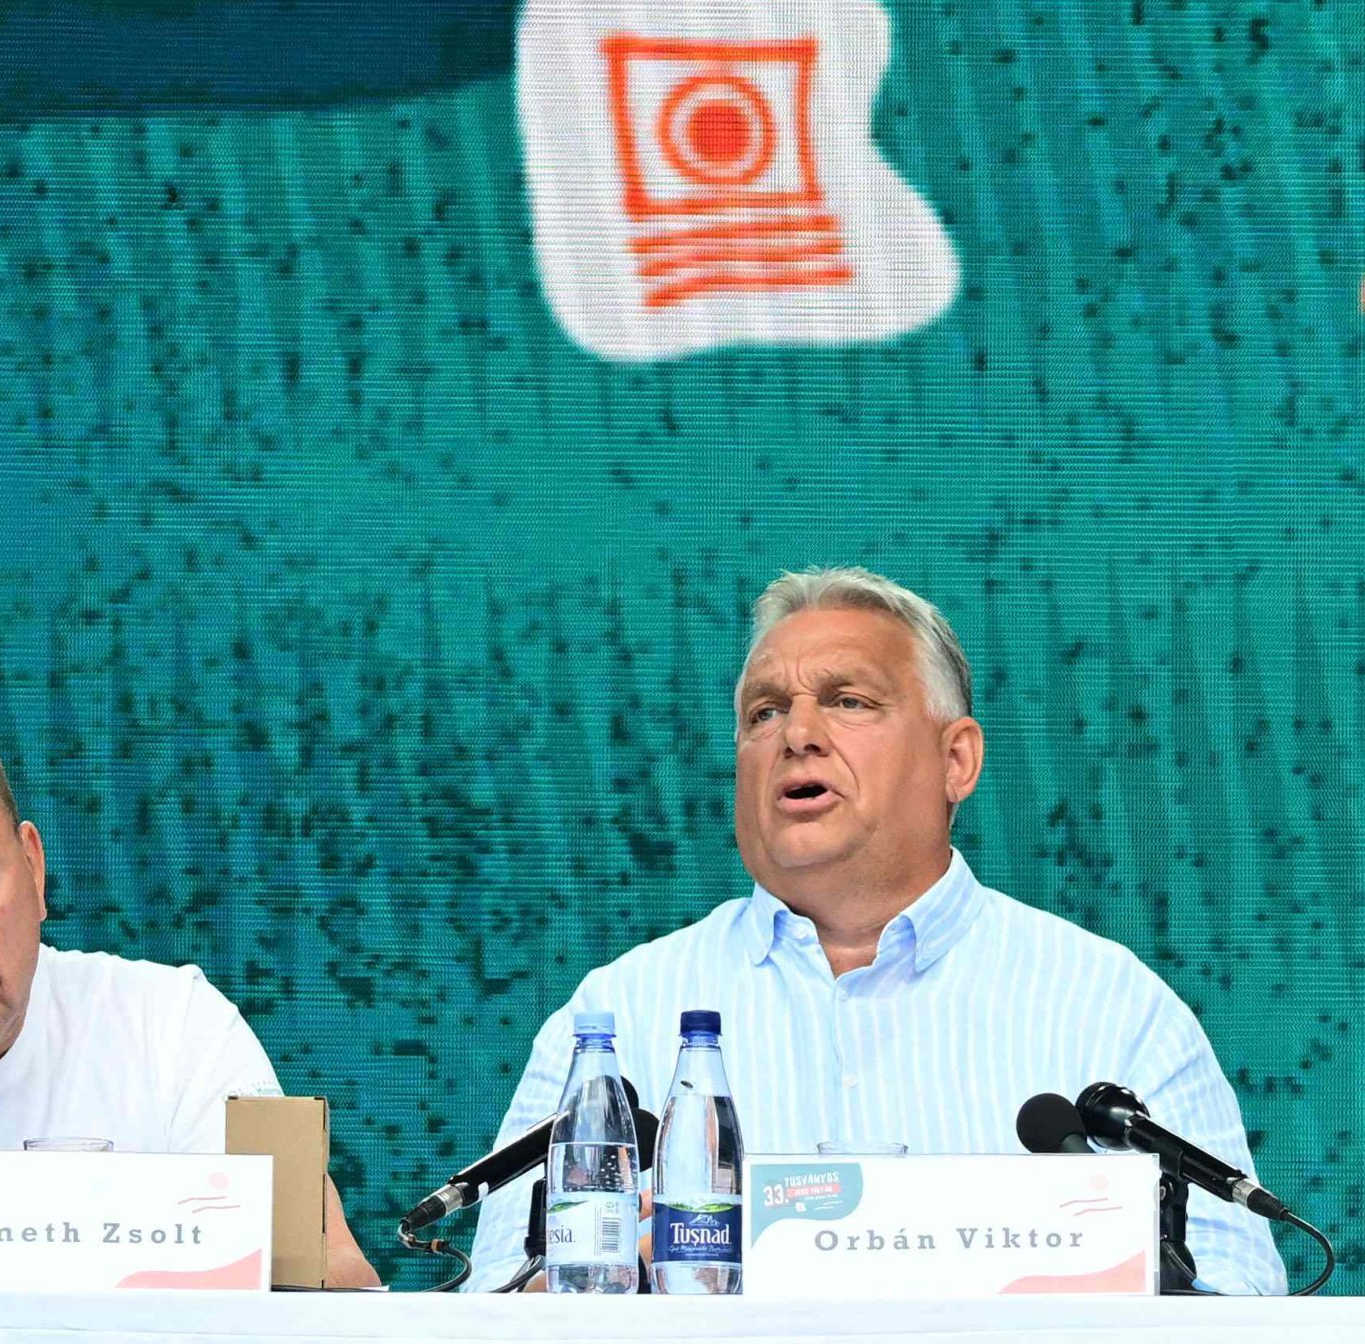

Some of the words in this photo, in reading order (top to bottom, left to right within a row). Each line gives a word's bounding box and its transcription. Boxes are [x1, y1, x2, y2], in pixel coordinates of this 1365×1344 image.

[763, 1183, 789, 1207] 33.
[102, 1222, 202, 1245] Zsolt
[814, 1228, 937, 1252] Orbán
[956, 1227, 1083, 1249] Viktor
